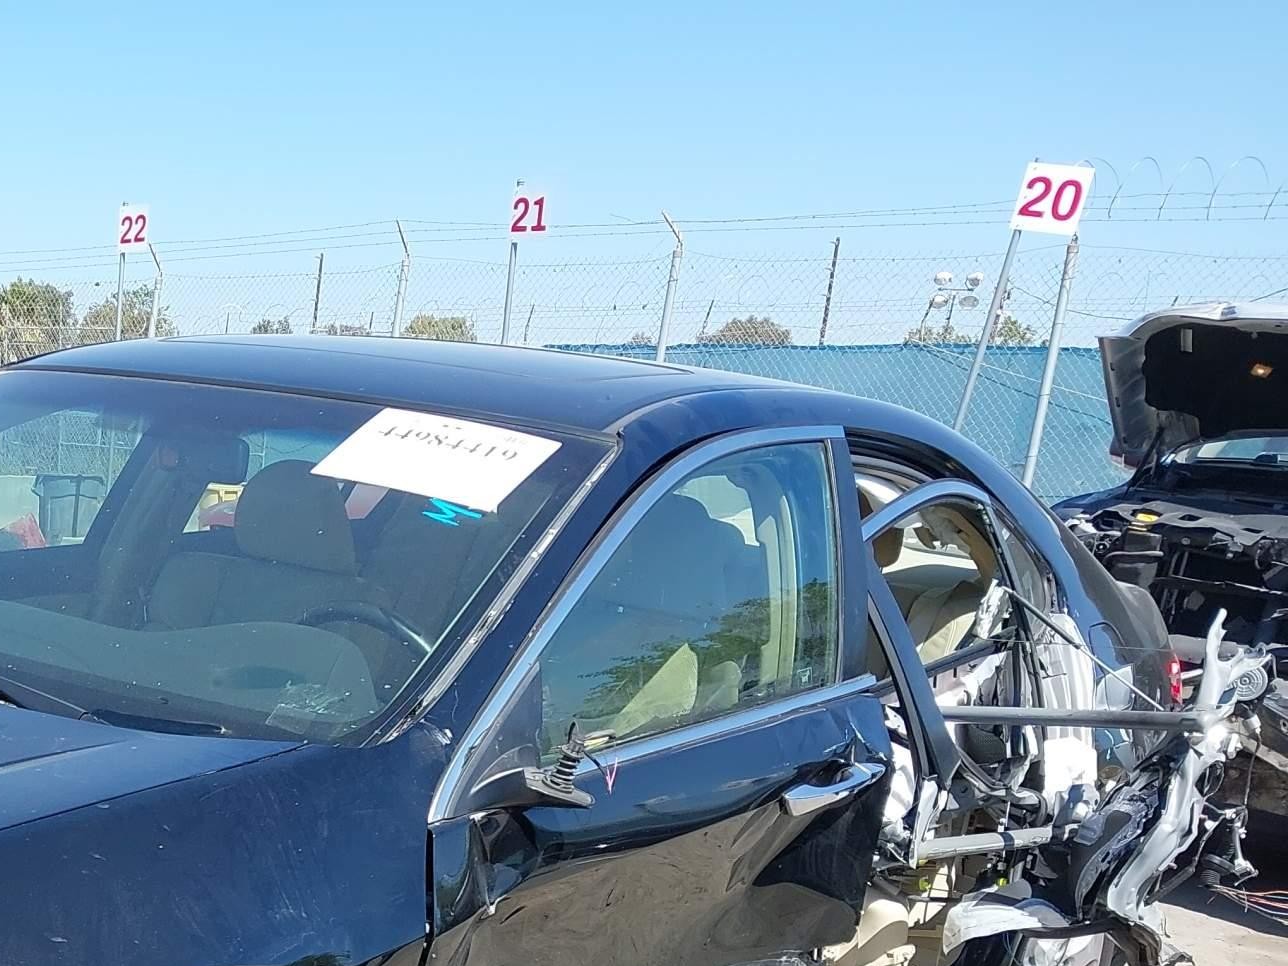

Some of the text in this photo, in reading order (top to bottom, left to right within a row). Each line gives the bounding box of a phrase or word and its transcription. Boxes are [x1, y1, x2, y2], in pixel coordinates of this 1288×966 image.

[511, 196, 546, 232] 21
[1017, 176, 1082, 221] 20
[120, 214, 146, 244] 22
